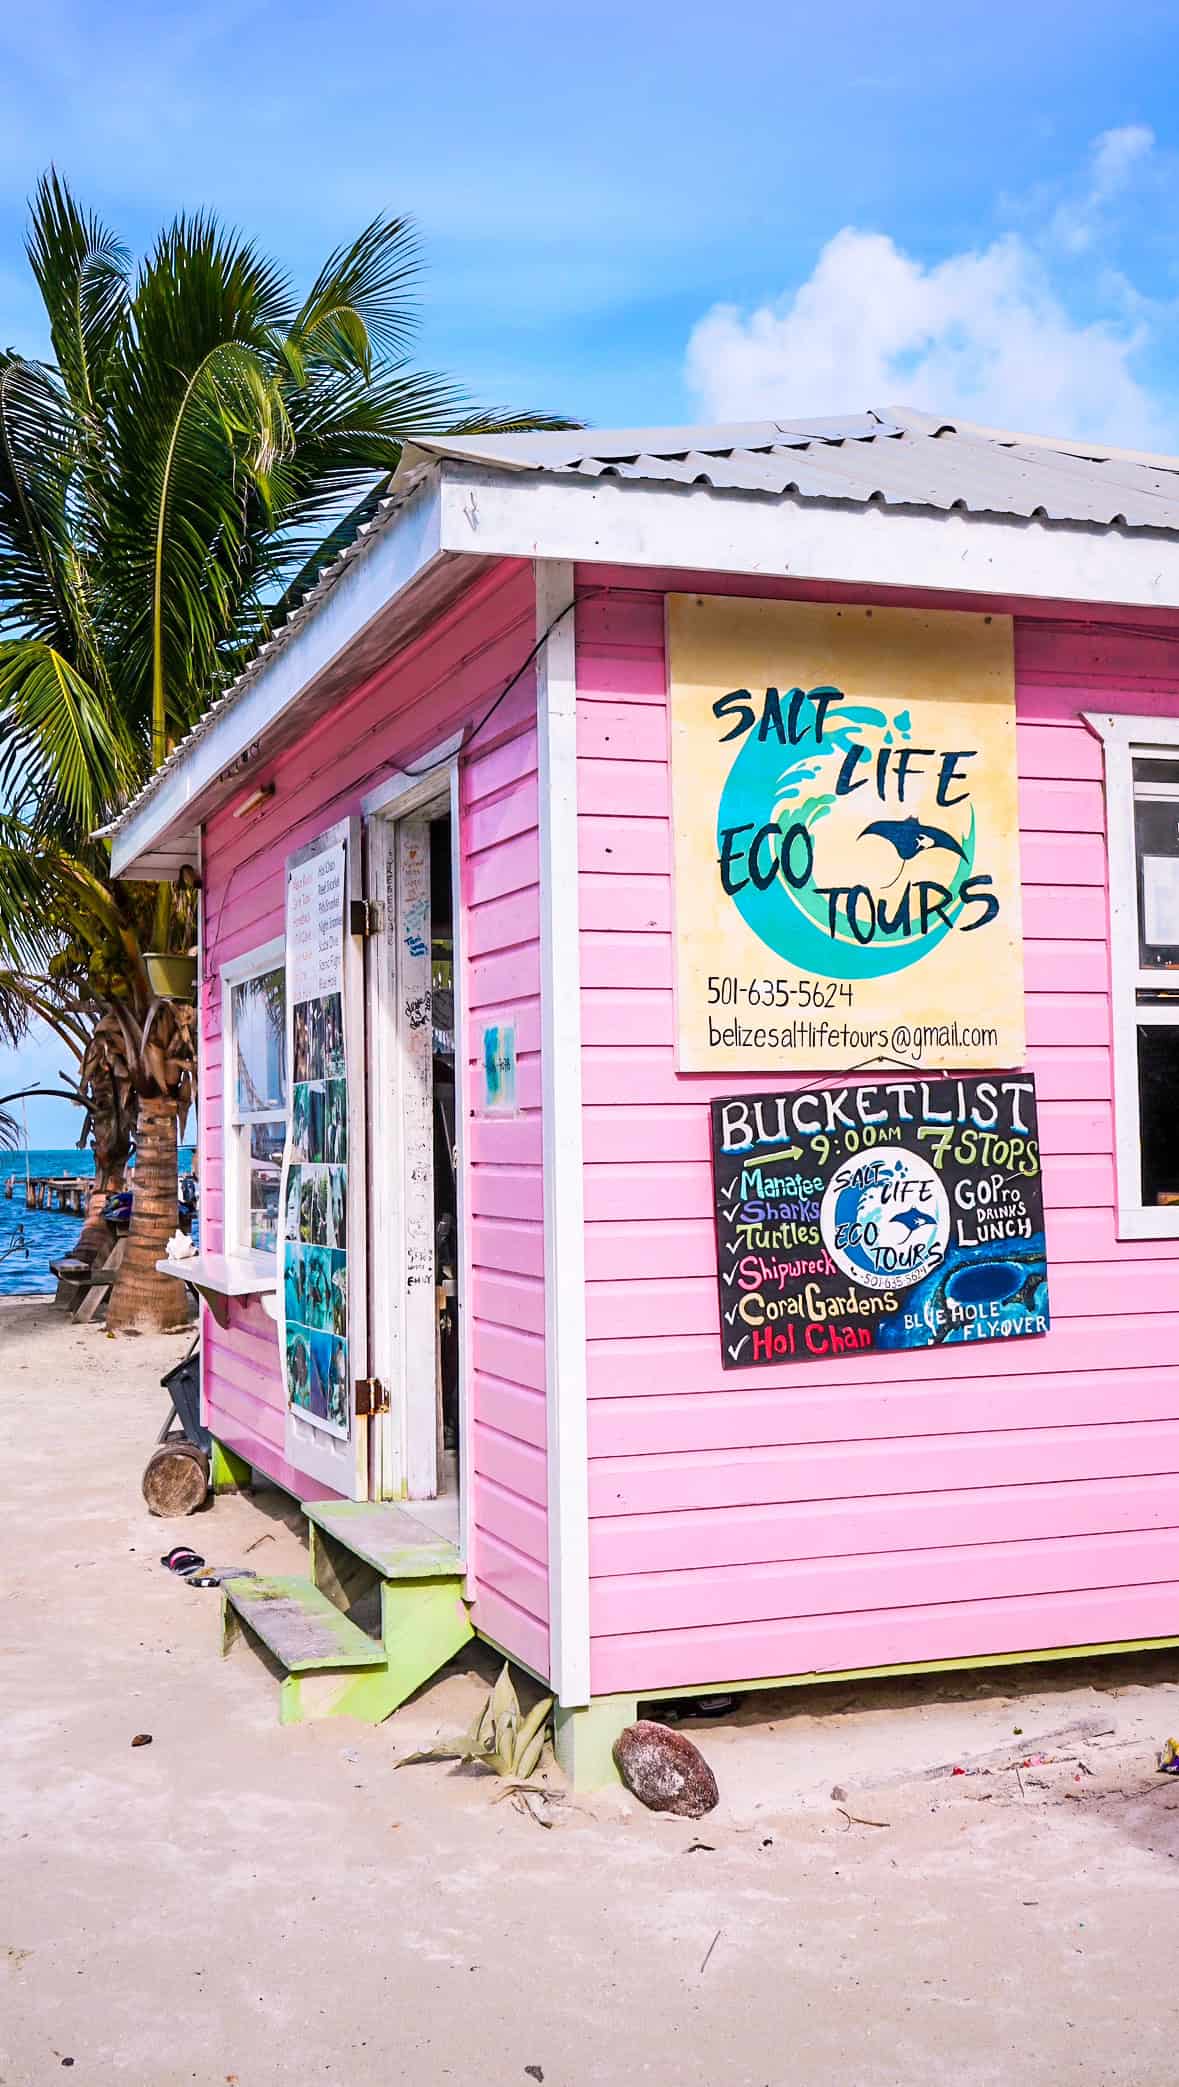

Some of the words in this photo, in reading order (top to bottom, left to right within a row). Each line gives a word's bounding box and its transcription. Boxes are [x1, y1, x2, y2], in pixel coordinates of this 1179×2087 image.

[712, 686, 844, 744] SALT
[835, 744, 977, 807] LIFE
[717, 822, 813, 896] ECO
[813, 874, 1000, 945] TOURS
[707, 976, 854, 1008] 501-635-5624
[708, 1015, 999, 1061] belizesaltlifetours@gmail.com
[917, 1126, 955, 1169] 7
[954, 1129, 1039, 1177] STOPS
[740, 1168, 825, 1201] Manatee
[833, 1160, 886, 1193] SALT
[880, 1179, 936, 1205] LIFE
[740, 1200, 820, 1224] Sharks
[976, 1201, 1027, 1224] DRINKS
[736, 1222, 820, 1250] Turtles
[834, 1221, 879, 1250] ECO
[956, 1218, 1033, 1248] LUNCH
[737, 1248, 837, 1291] Shipwreck
[870, 1241, 944, 1271] TOURS
[903, 1297, 947, 1331] BLUE
[951, 1301, 1001, 1323] HOLE
[752, 1323, 796, 1361] Hol
[804, 1322, 873, 1355] Chan
